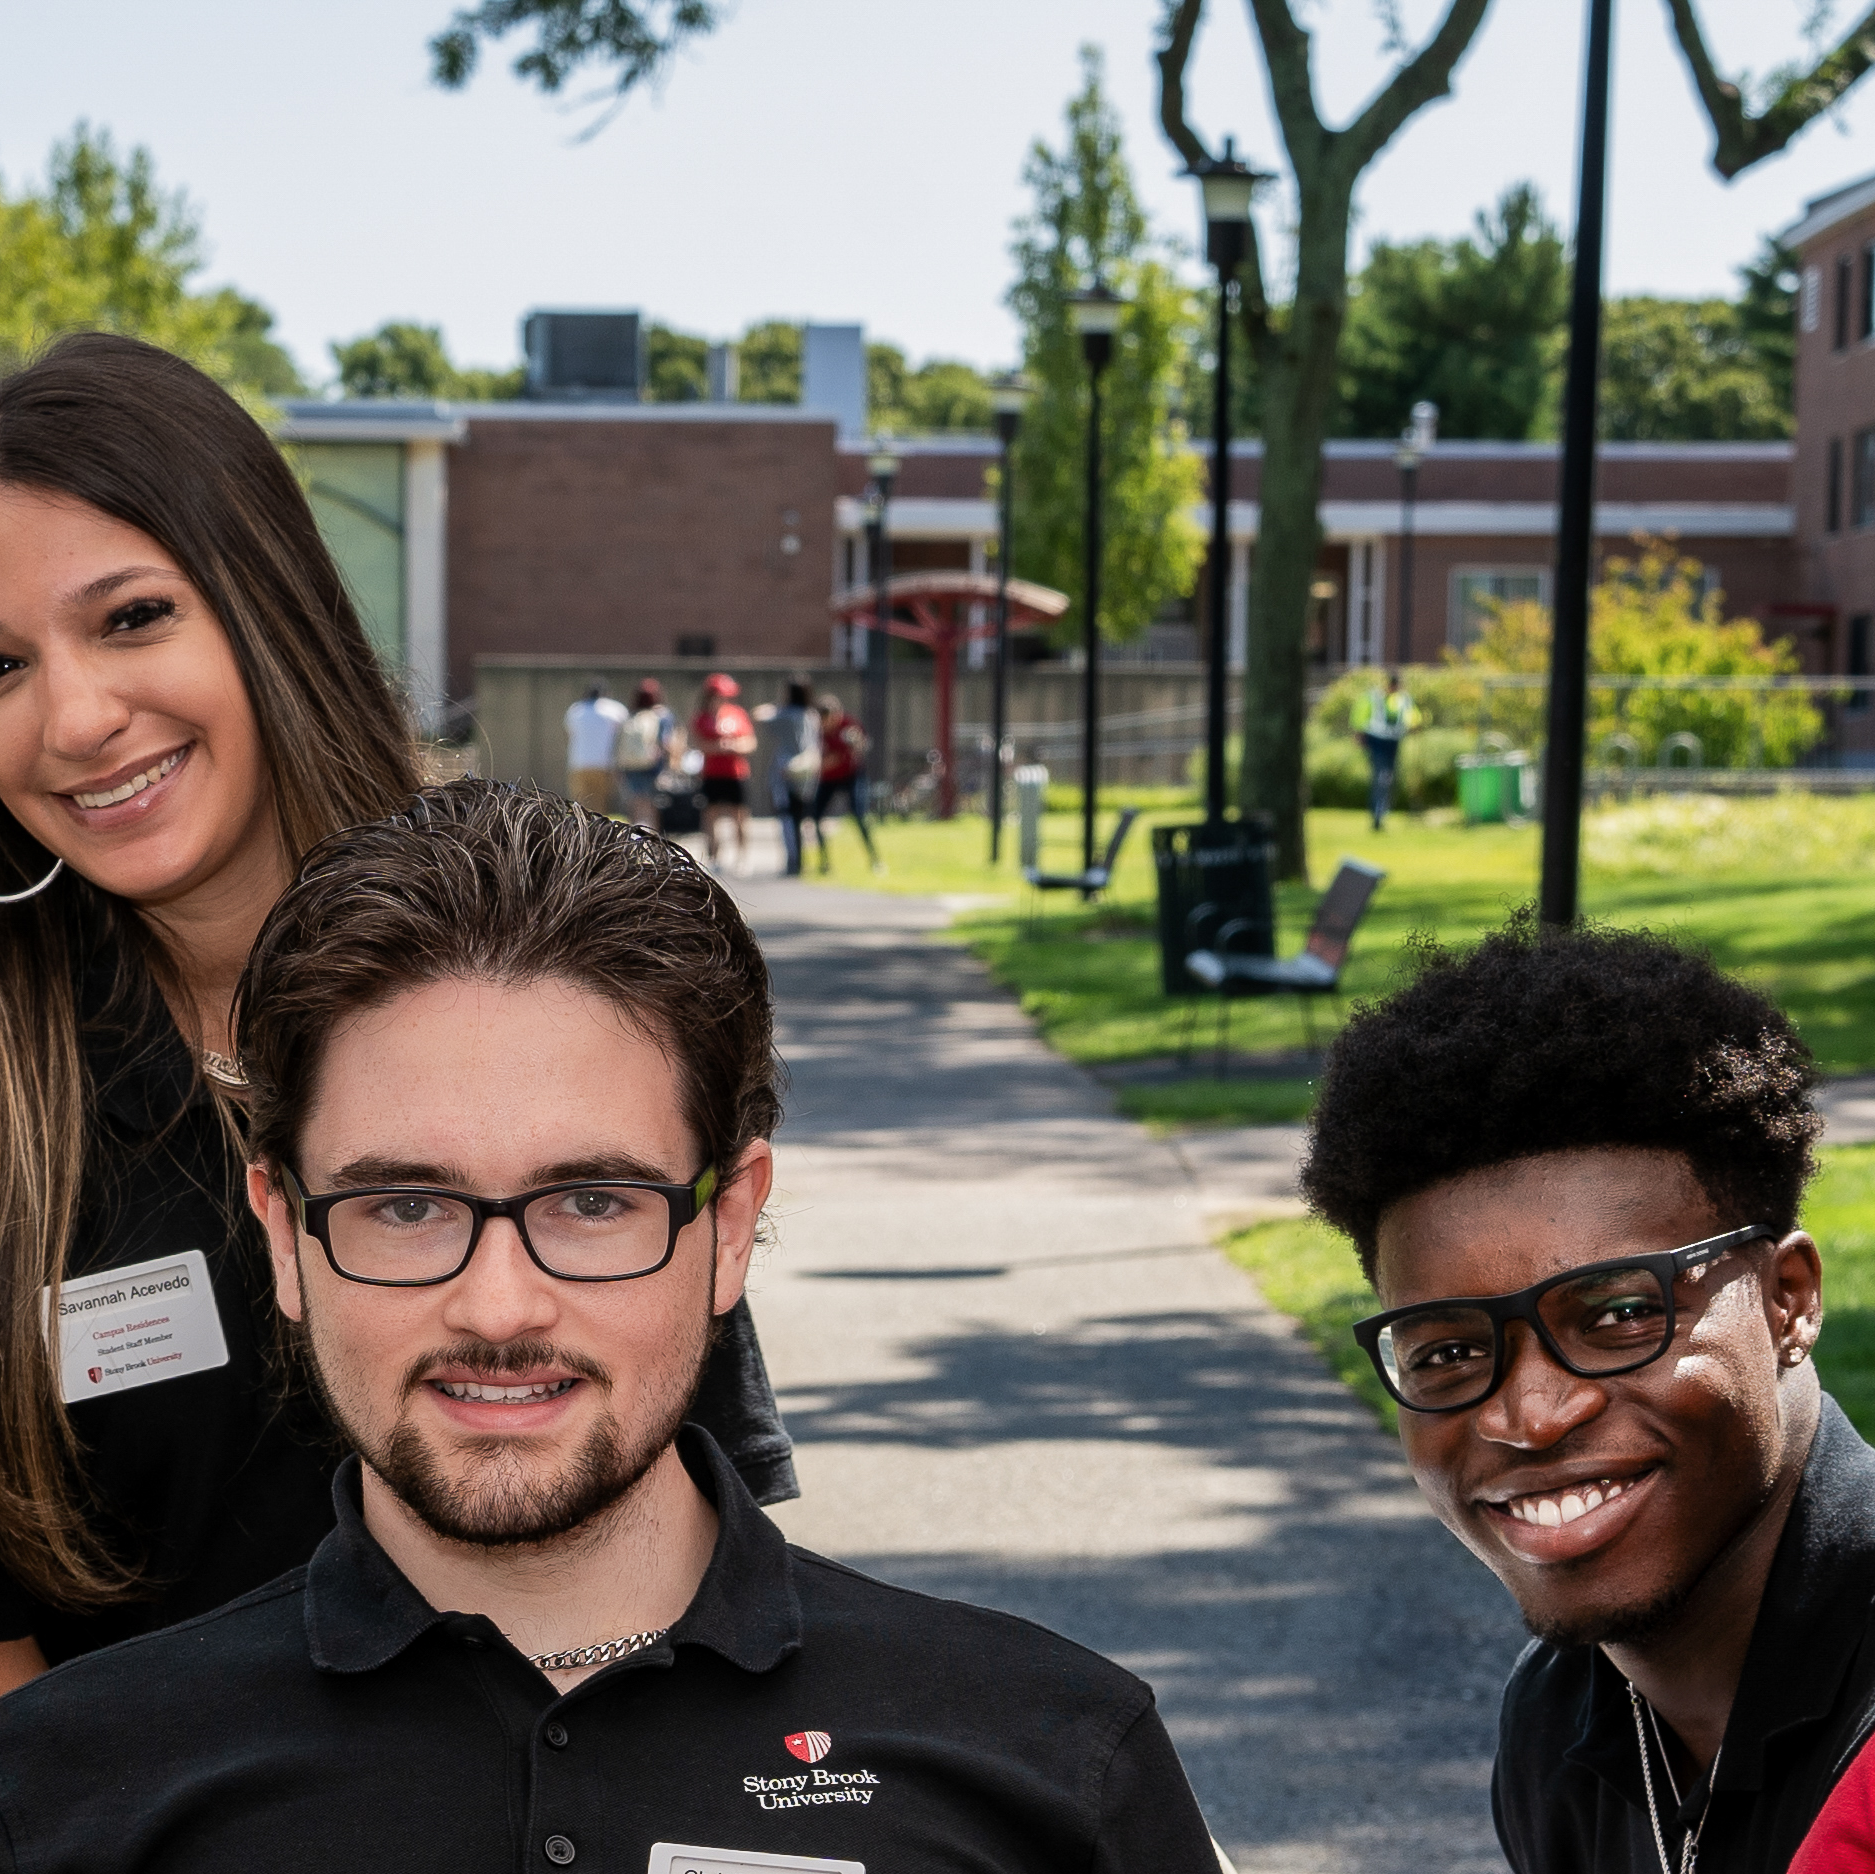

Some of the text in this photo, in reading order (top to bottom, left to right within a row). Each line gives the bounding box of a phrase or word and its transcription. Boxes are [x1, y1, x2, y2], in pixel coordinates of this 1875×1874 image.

[58, 1275, 190, 1317] Savannah Acevedo
[92, 1316, 171, 1341] Campus Residences
[144, 1331, 173, 1346] Member
[125, 1360, 147, 1372] Brook
[146, 1351, 183, 1367] University
[743, 1769, 881, 1794] Stony Brook
[756, 1787, 874, 1810] University
